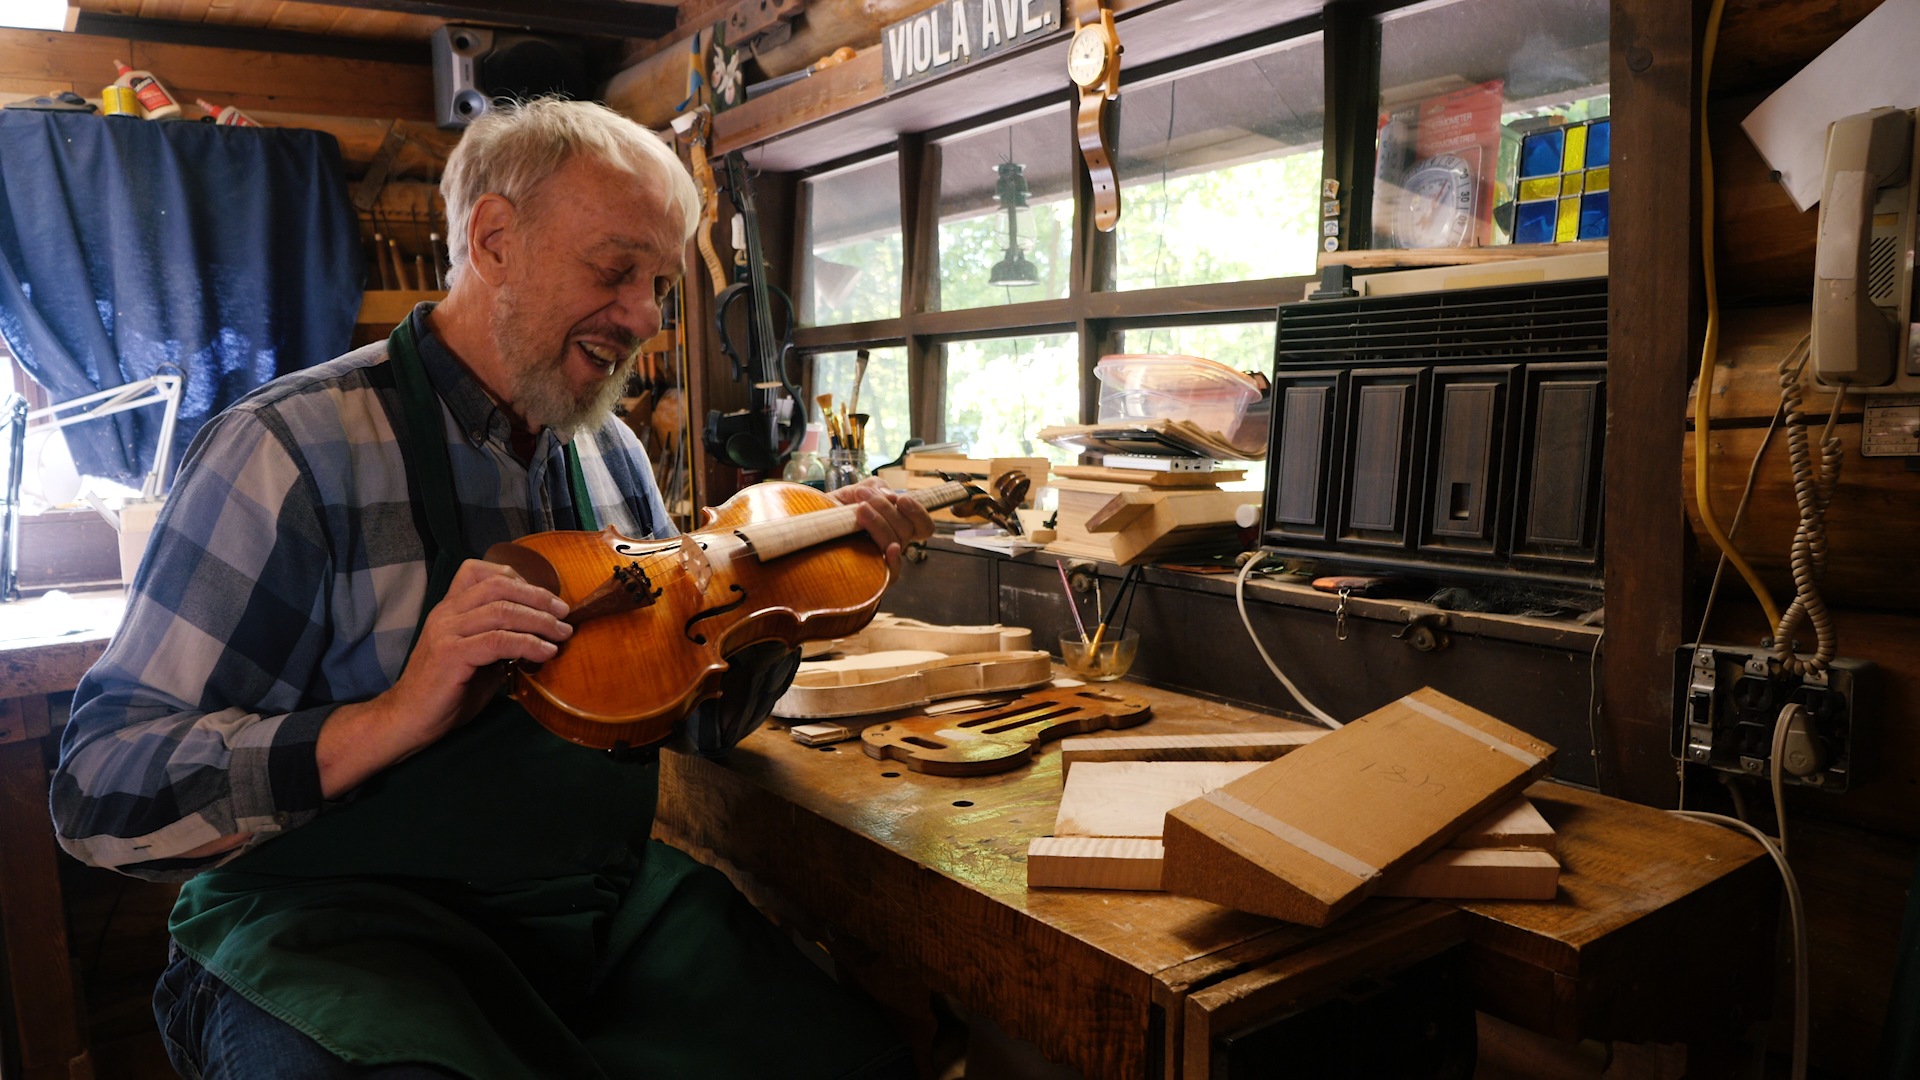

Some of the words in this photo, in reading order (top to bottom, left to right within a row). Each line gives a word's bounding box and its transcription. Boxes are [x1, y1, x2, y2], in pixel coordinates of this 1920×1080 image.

[888, 0, 971, 82] VIOLA
[982, 0, 1052, 51] AVE.
[1425, 112, 1473, 130] THERMOMETER
[1460, 191, 1471, 203] 30
